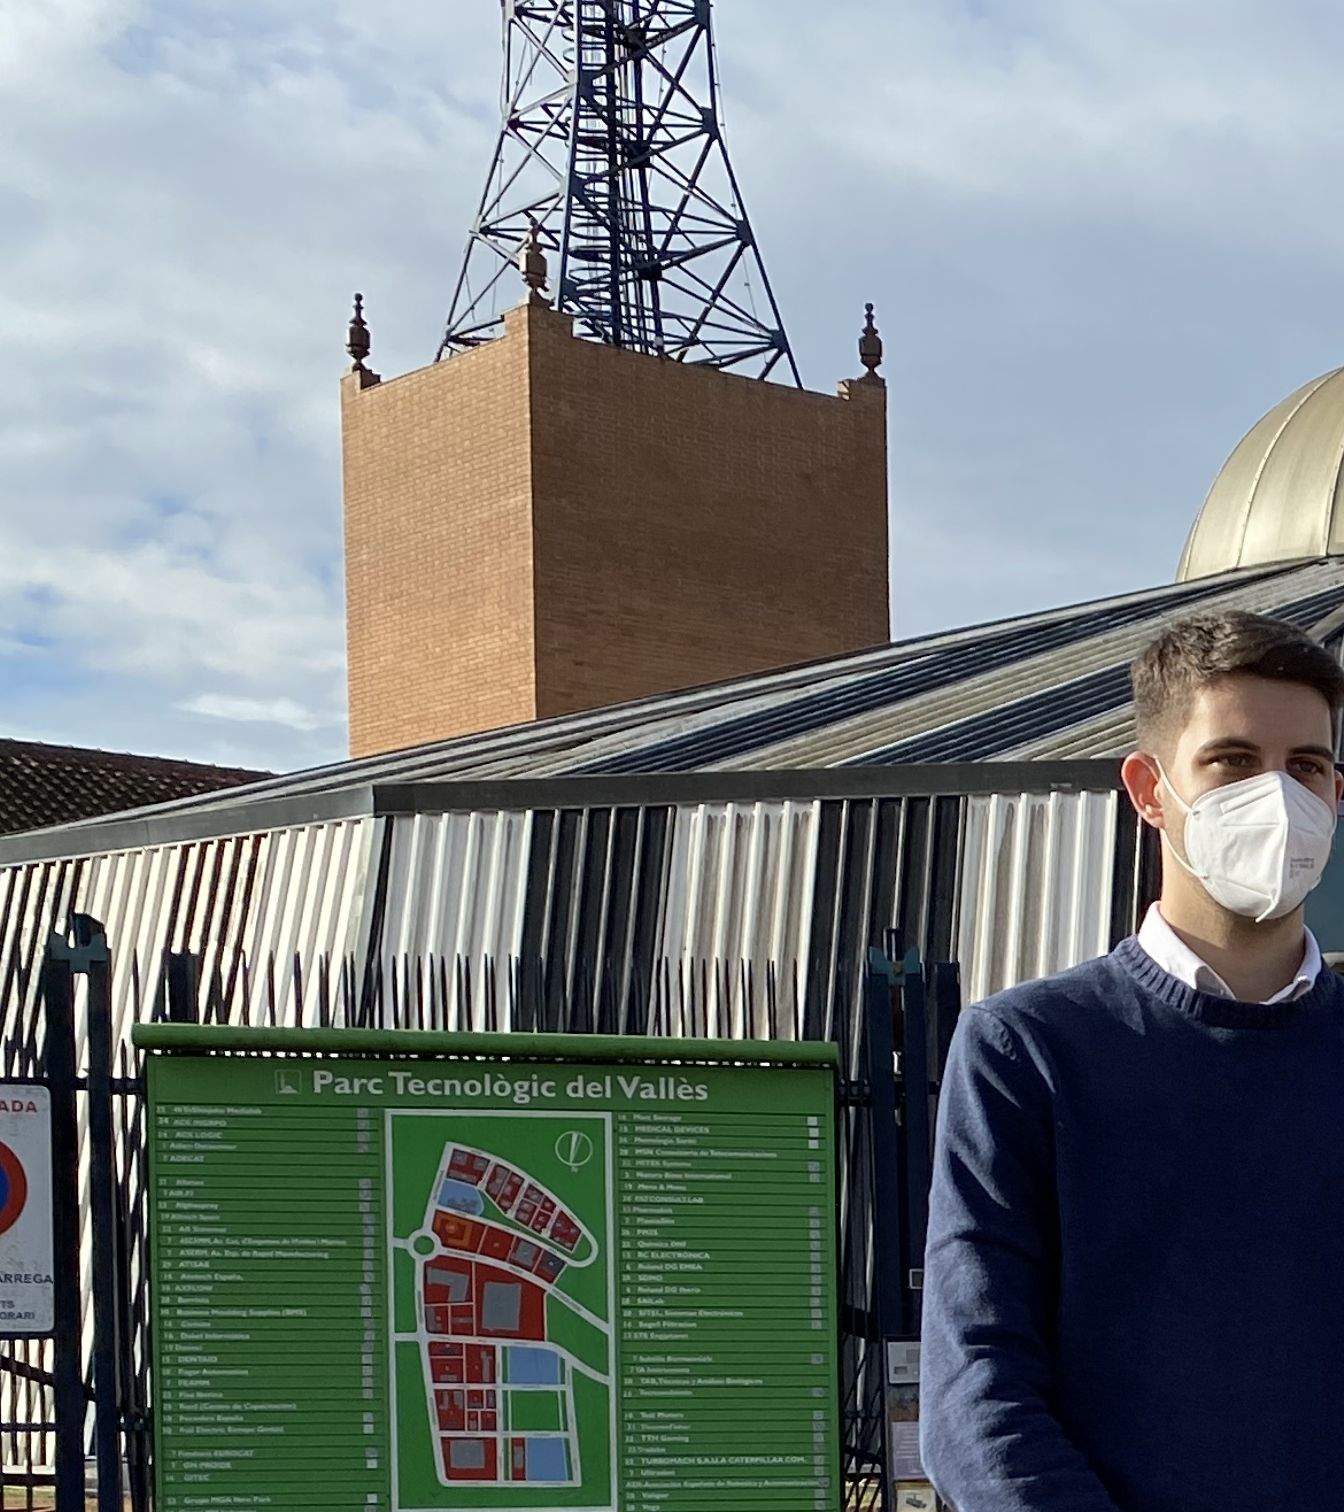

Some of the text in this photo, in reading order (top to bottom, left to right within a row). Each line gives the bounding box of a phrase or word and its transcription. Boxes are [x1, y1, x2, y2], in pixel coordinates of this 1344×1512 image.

[313, 1070, 708, 1104] Parc Tecnològic del Vallès
[0, 1273, 53, 1284] RREGA
